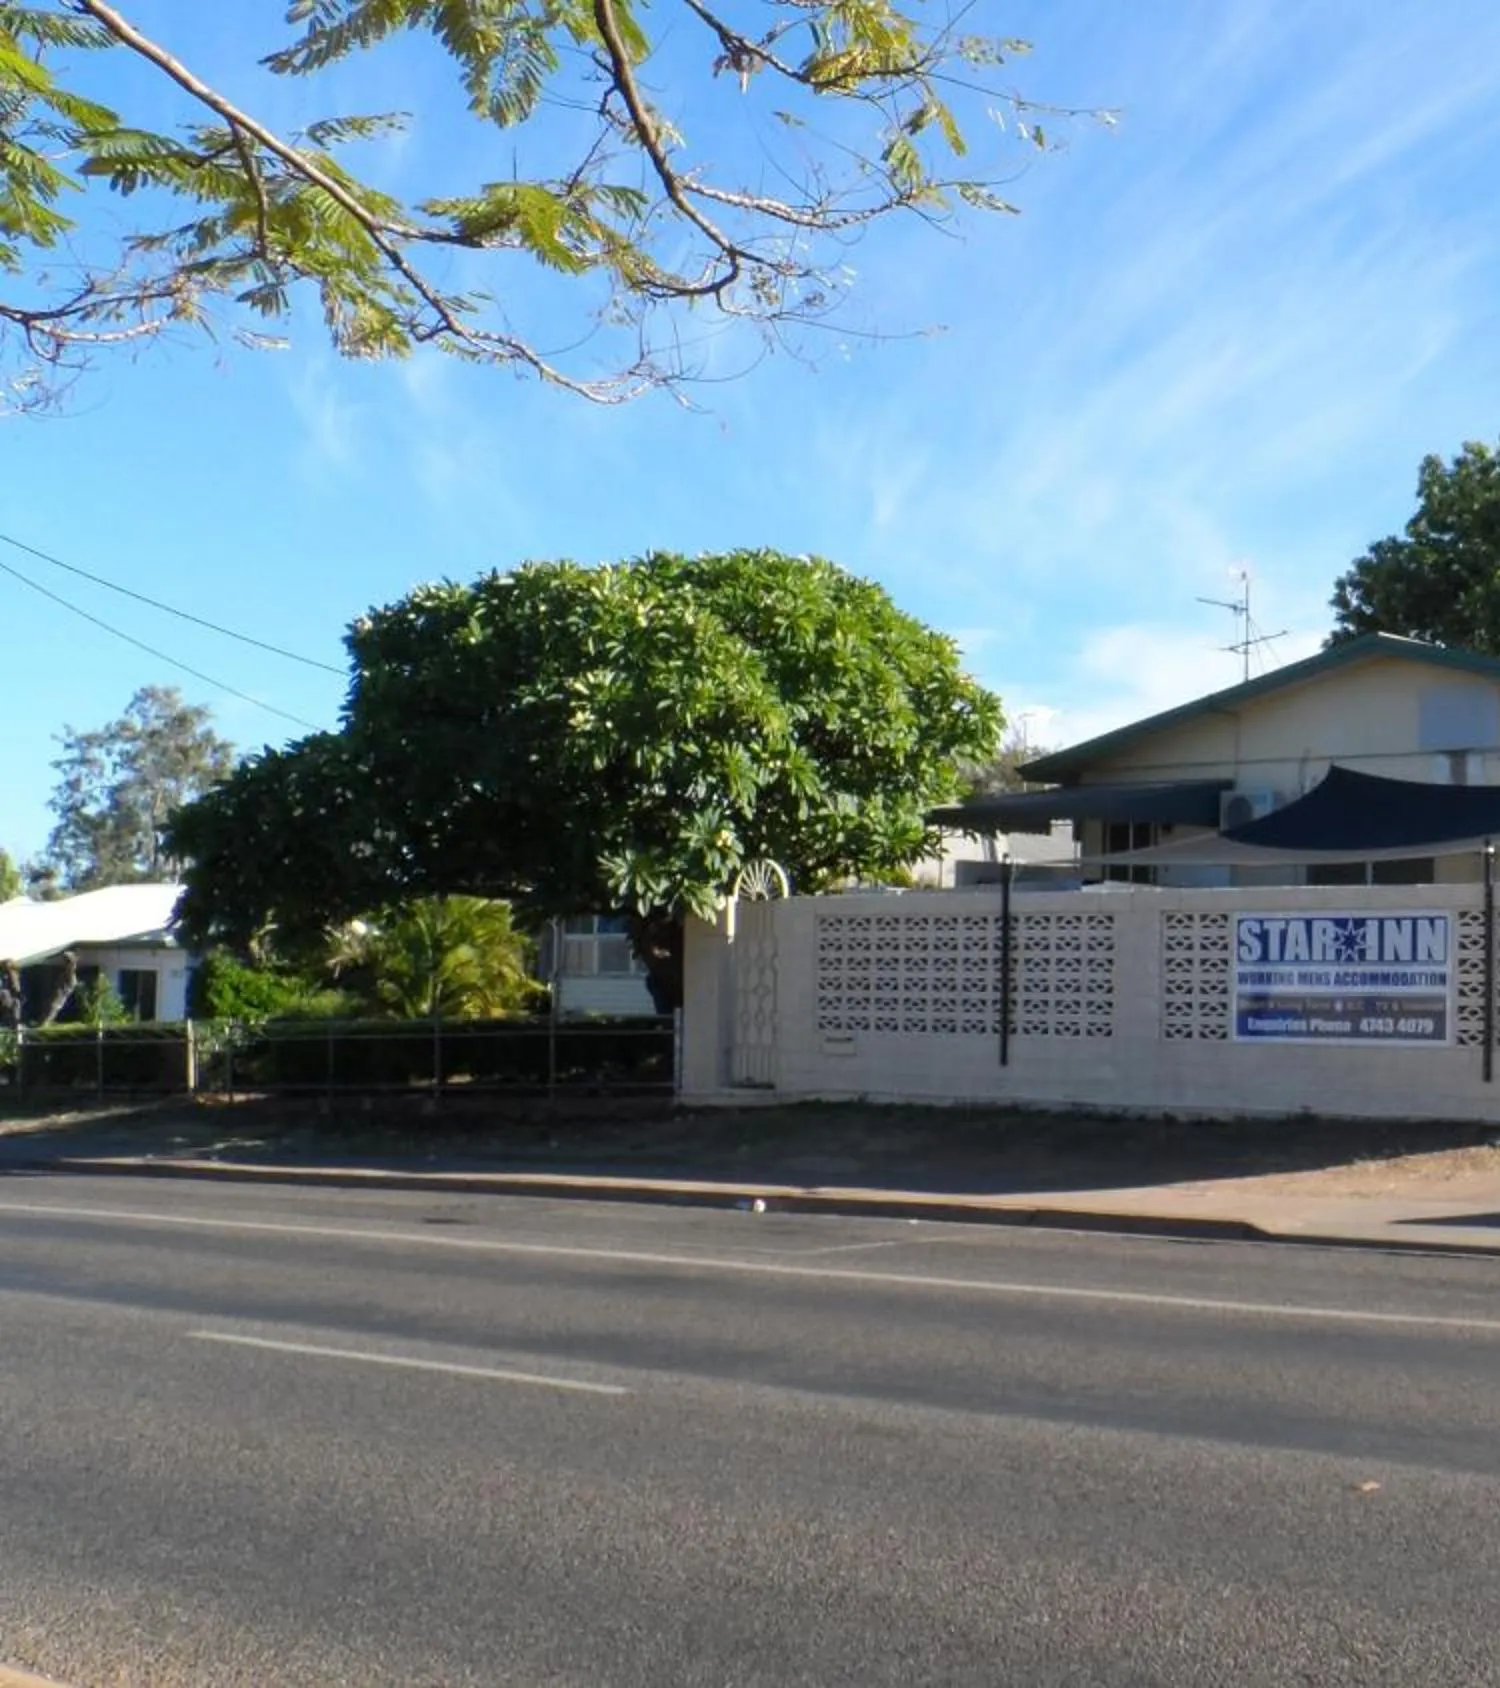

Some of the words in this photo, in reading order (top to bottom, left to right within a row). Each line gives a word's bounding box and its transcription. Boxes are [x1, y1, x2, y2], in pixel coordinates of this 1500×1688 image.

[1238, 919, 1337, 962] STAR
[1365, 918, 1446, 961] INN
[1238, 971, 1294, 986] WORKING
[1298, 971, 1332, 986] MENS
[1334, 971, 1446, 987] ACCOMMODATION
[1360, 1017, 1393, 1033] 4743
[1397, 1017, 1434, 1034] 4079
